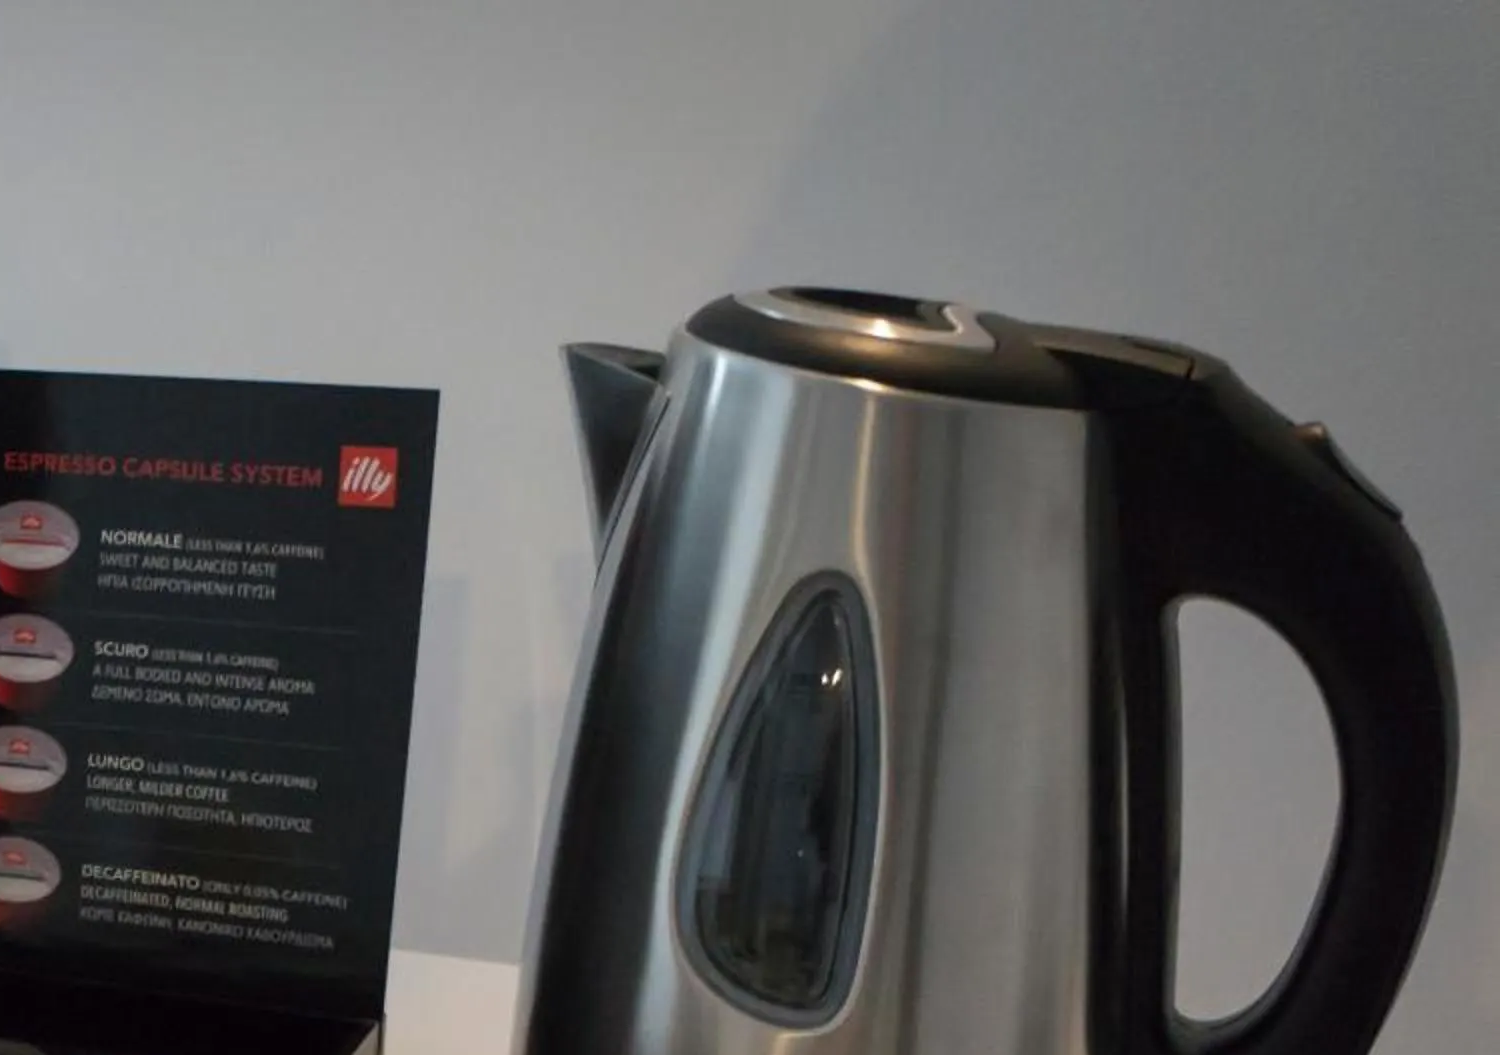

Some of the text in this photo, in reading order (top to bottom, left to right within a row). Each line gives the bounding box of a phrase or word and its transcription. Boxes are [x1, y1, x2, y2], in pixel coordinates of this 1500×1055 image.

[4, 452, 323, 487] ESPRESSO CAPSULE SYSTEM
[342, 455, 393, 501] illy
[100, 529, 183, 549] NORMALE
[99, 551, 277, 578] SWEET AND BALANCED TASTE
[93, 640, 149, 659] SCURO
[92, 663, 315, 695] A FULL BODIED AND INTENSE AROMA
[87, 753, 145, 771] LUNGO
[182, 763, 217, 779] THAN
[138, 779, 183, 797] MILDER
[185, 783, 228, 802] COFFEE
[81, 863, 200, 890] DECAFFEINATO
[176, 895, 225, 914] NORMAL
[229, 900, 289, 922] ROASTING
